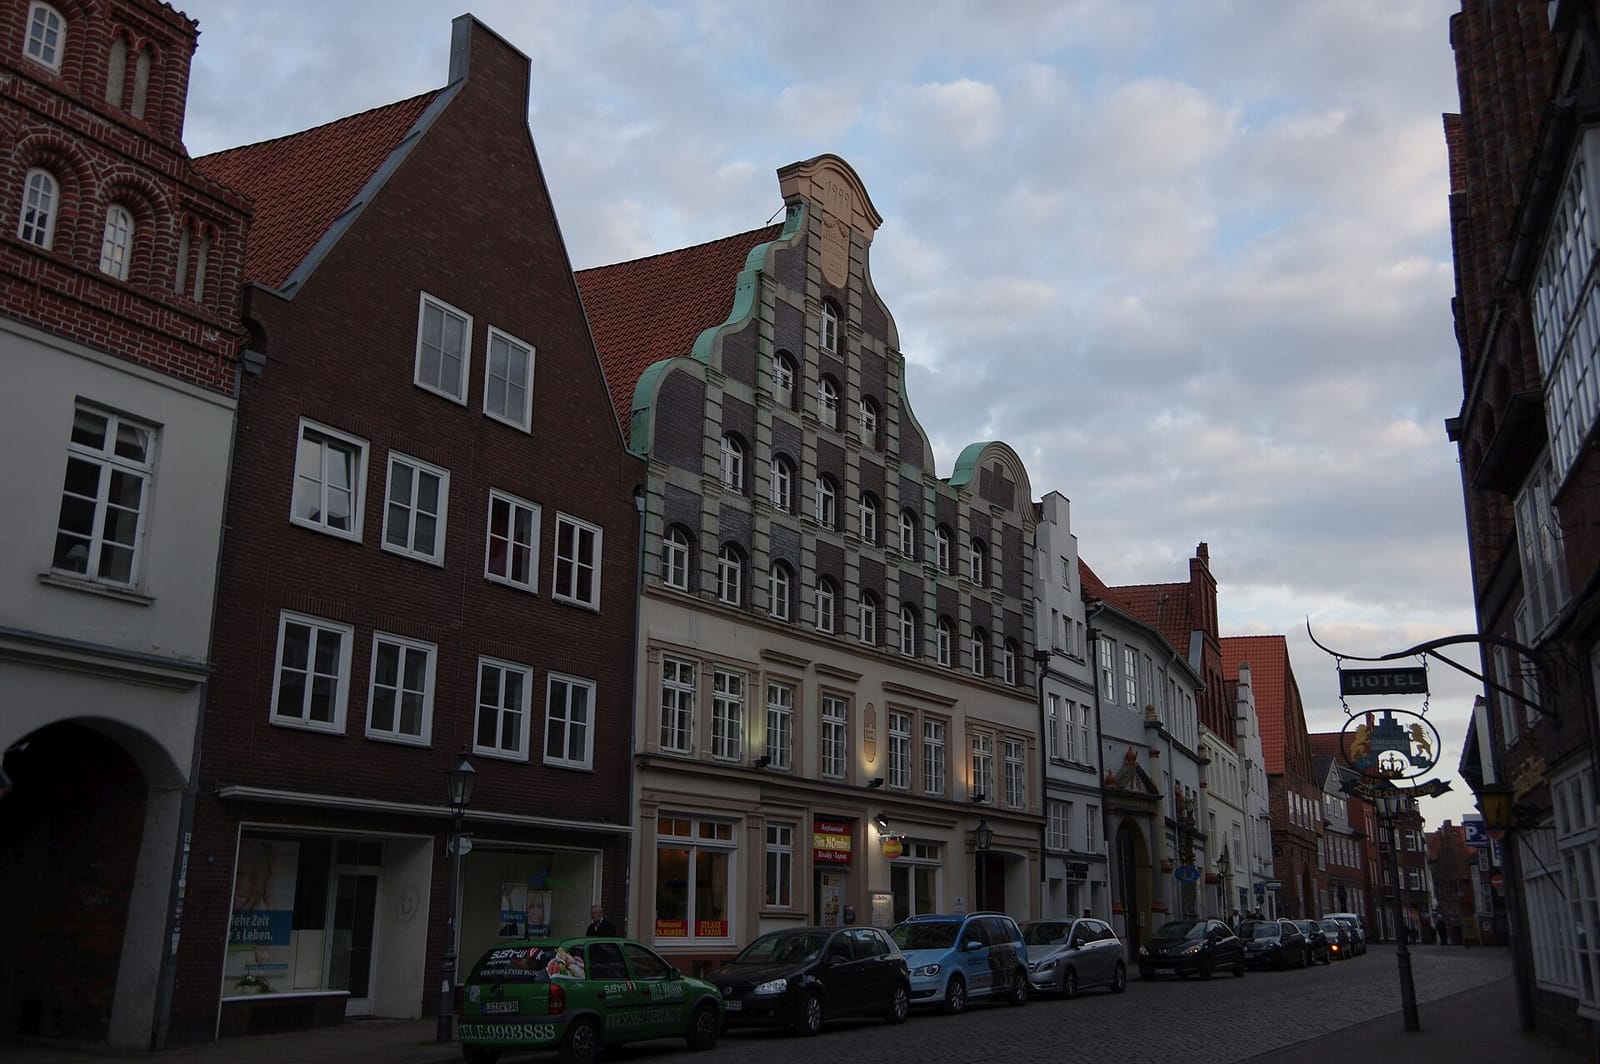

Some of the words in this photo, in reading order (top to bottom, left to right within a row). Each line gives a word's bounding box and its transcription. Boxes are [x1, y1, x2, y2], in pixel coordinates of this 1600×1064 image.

[1351, 674, 1421, 688] HOTEL
[1466, 825, 1479, 841] P
[252, 913, 271, 927] Zeit
[243, 928, 273, 941] Leben.
